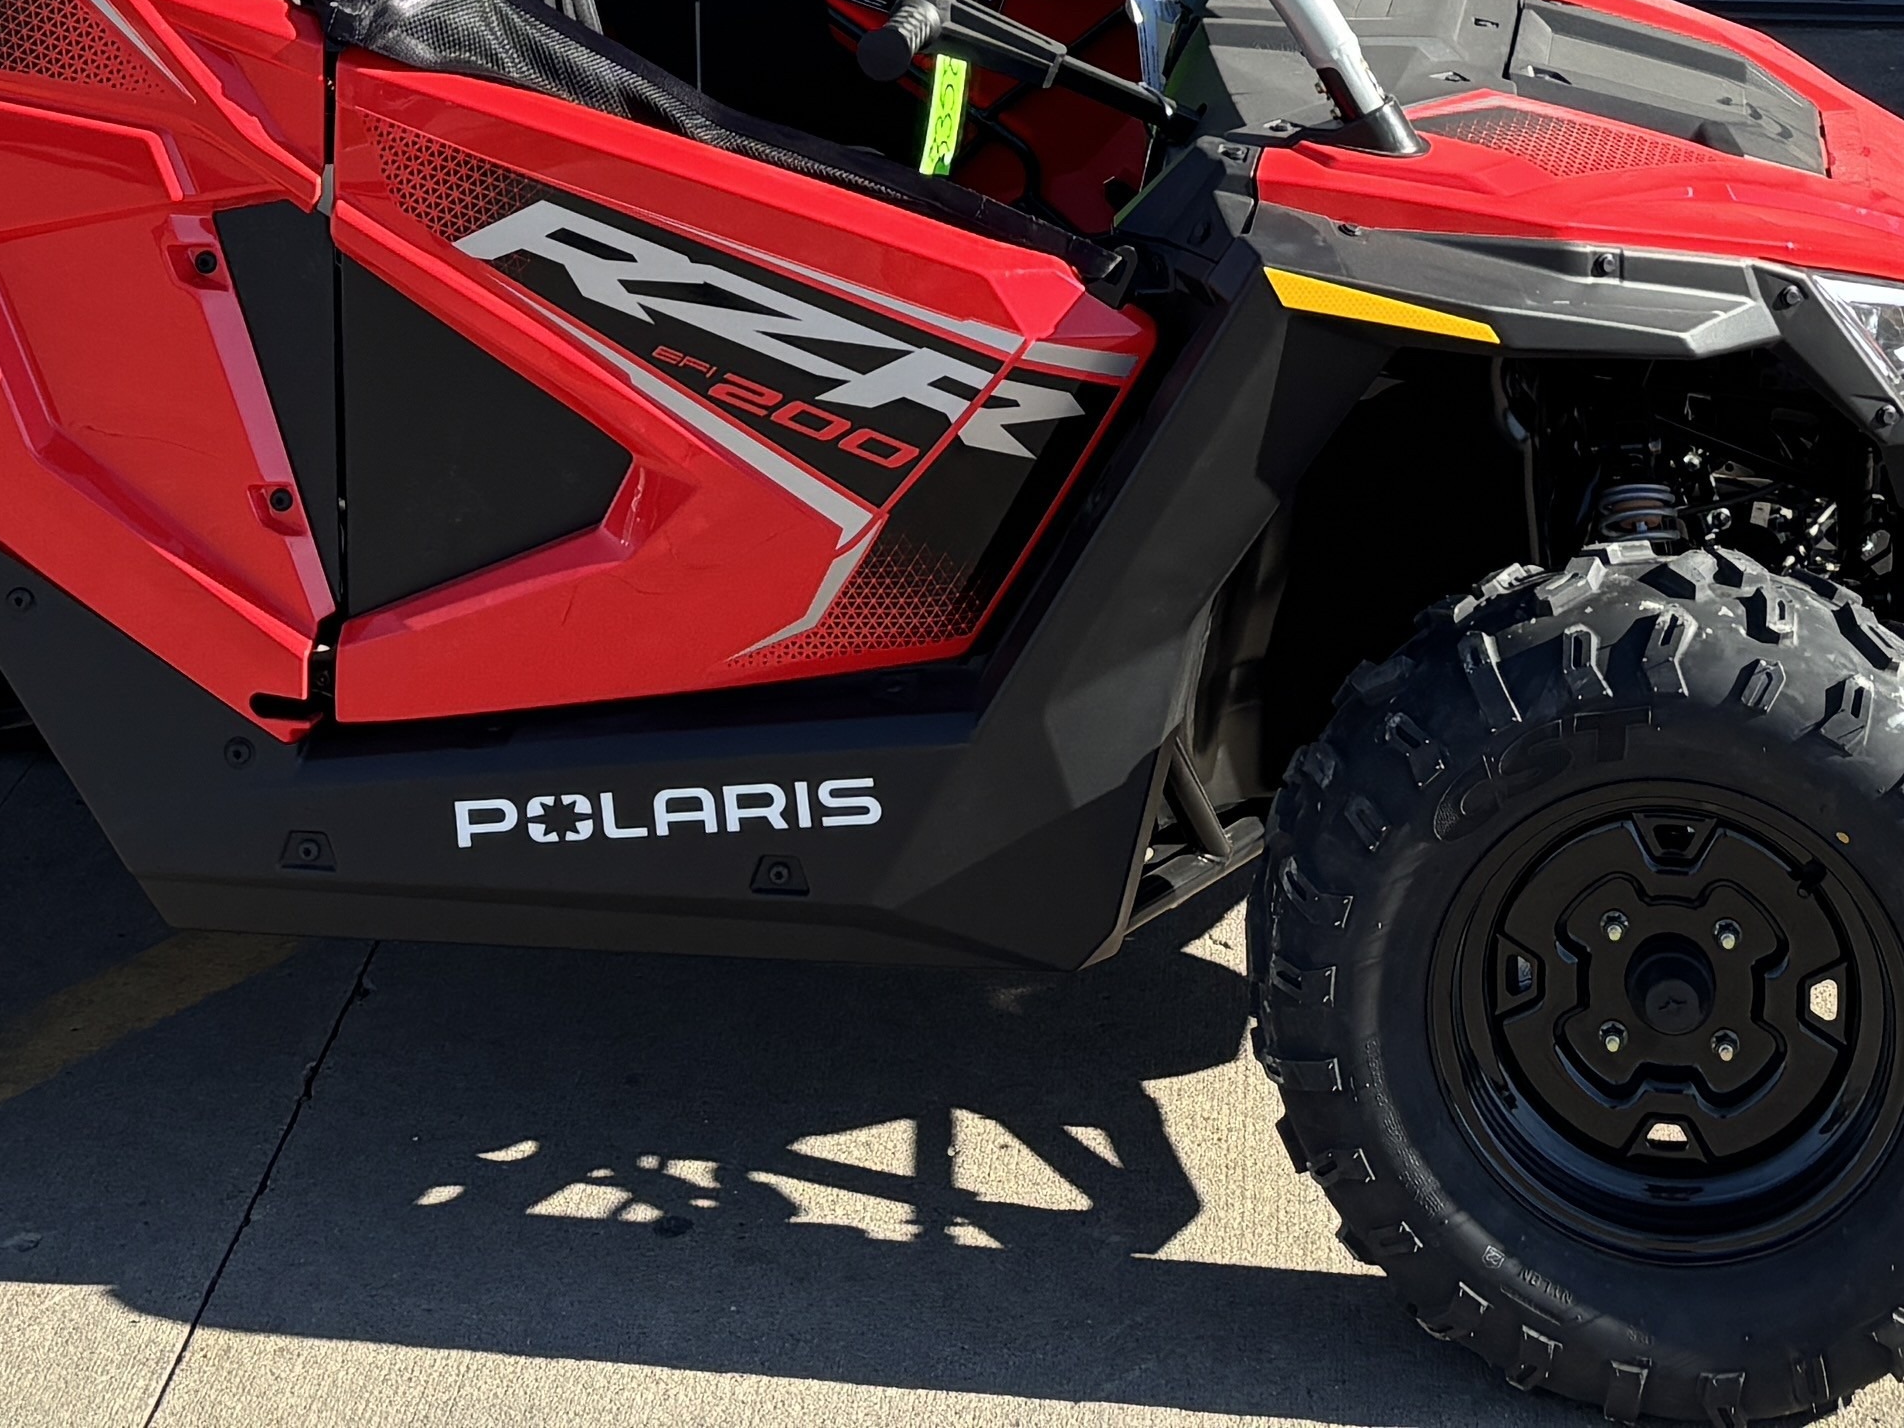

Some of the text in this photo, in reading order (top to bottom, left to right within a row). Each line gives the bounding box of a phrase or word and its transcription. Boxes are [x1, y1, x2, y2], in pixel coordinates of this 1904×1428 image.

[452, 199, 1086, 459] RZR
[651, 345, 921, 470] EFI 200
[453, 776, 883, 849] POLARIS
[1433, 704, 1653, 842] CST
